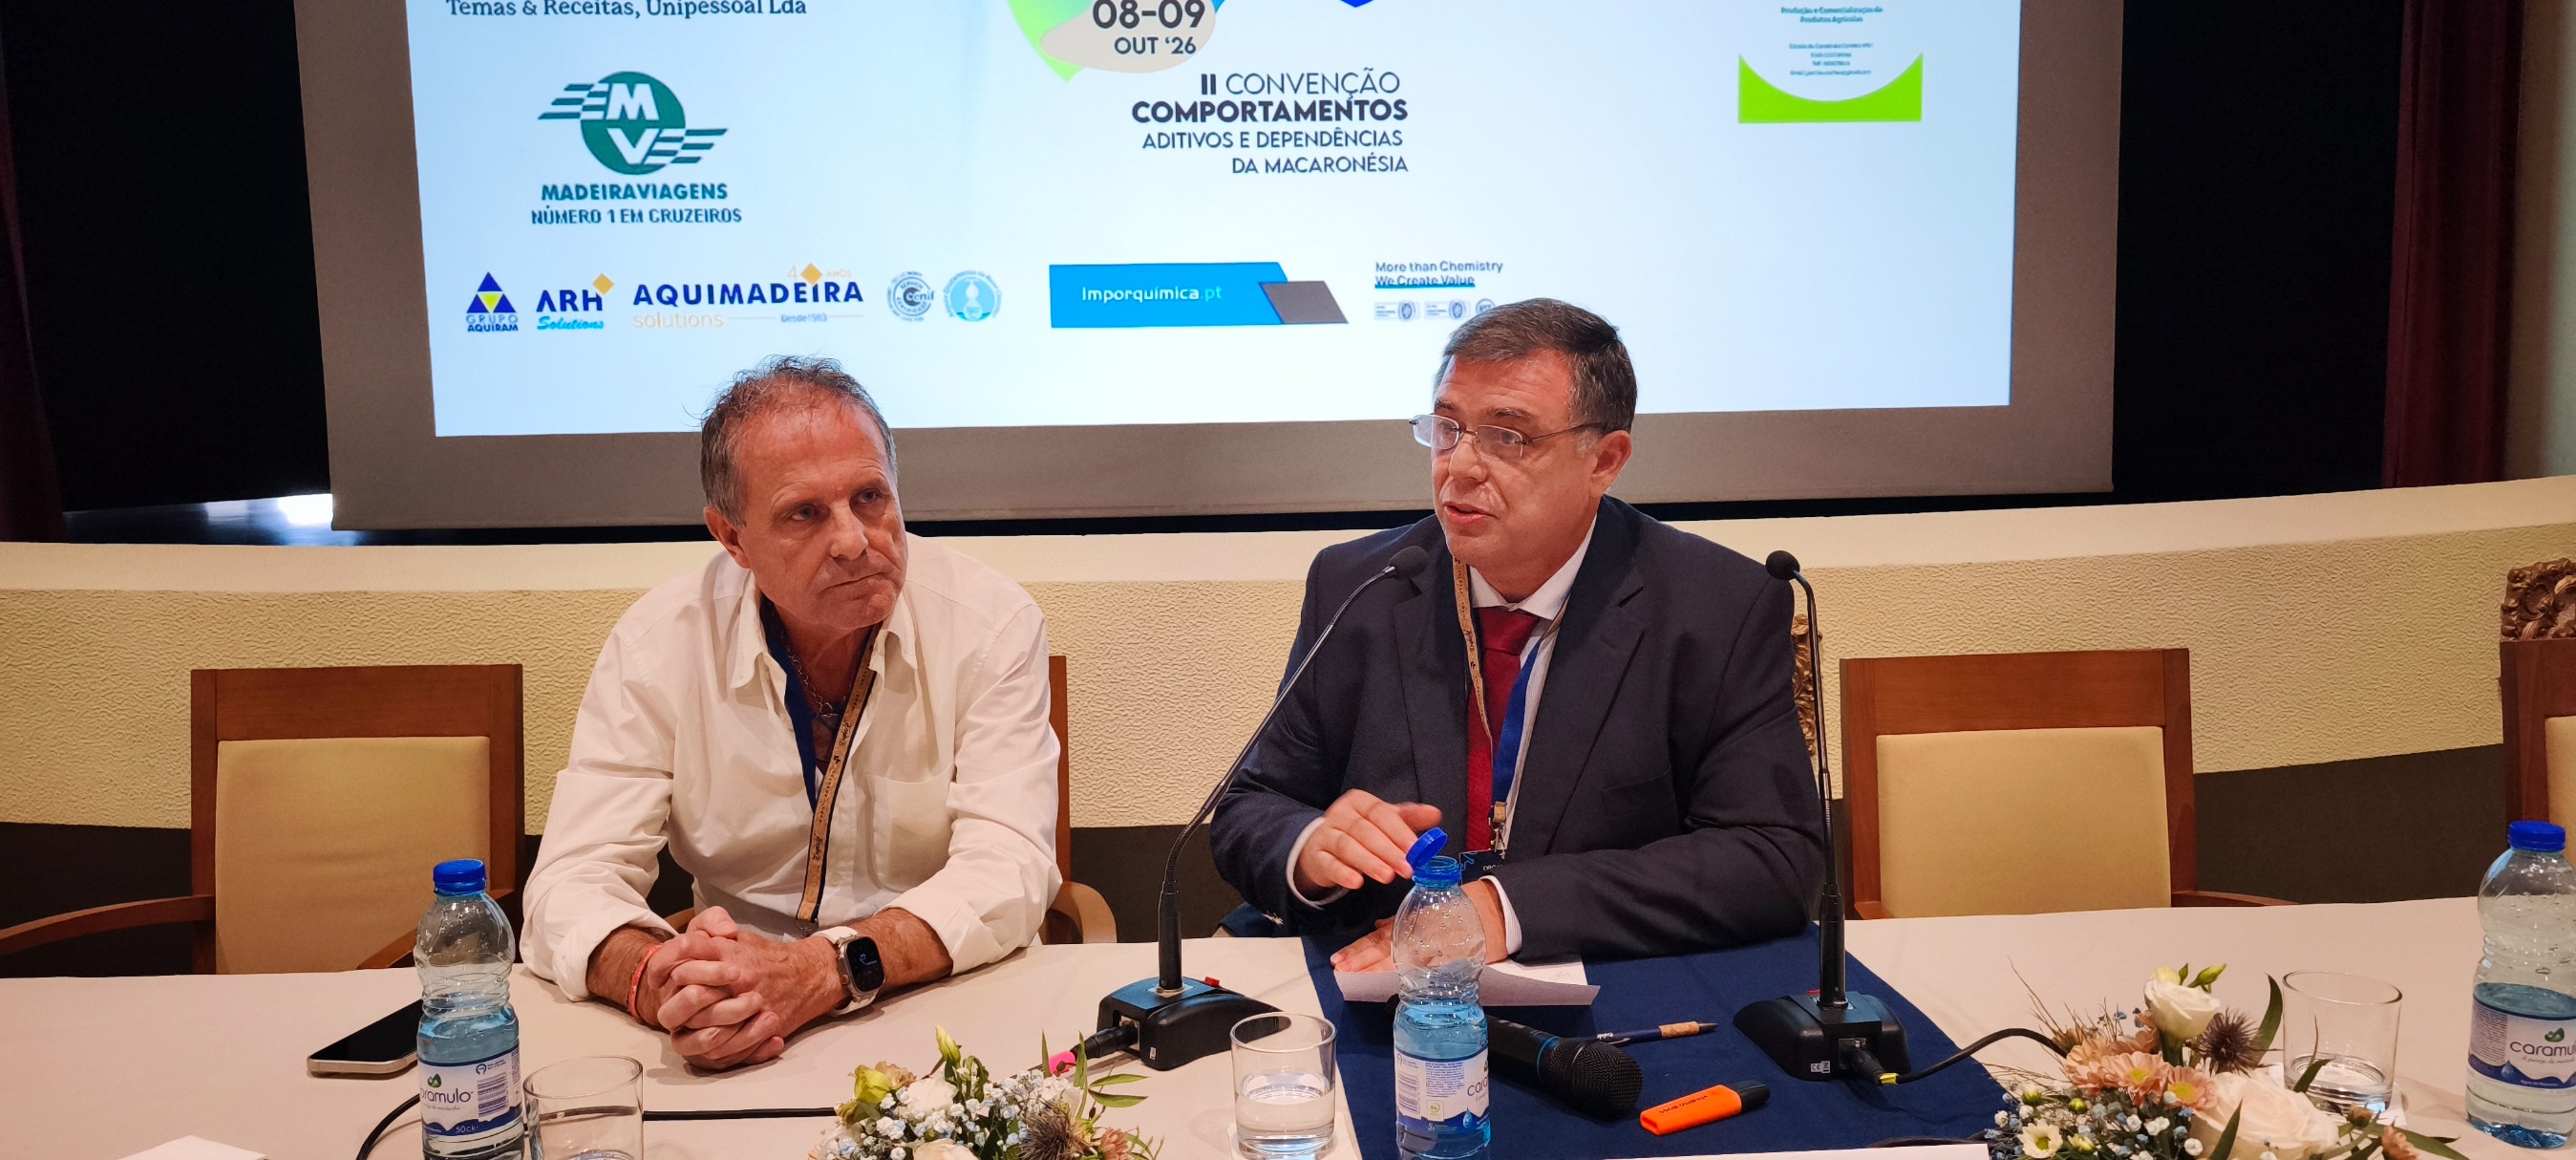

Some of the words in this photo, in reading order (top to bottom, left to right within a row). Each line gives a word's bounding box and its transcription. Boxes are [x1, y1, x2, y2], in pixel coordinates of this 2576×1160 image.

[446, 0, 517, 16] Temas
[522, 0, 538, 16] &
[543, 0, 641, 19] Receitas,
[646, 0, 763, 19] Unipessoal
[769, 0, 807, 14] Lda
[1093, 0, 1205, 30] 08-09
[1114, 36, 1159, 55] OUT
[1201, 73, 1217, 96] II
[1225, 67, 1400, 99] CONVENÇÃO
[606, 83, 659, 120] M
[1132, 98, 1409, 123] COMPORTAMENTOS
[1142, 131, 1234, 149] ADITIVOS
[1240, 131, 1250, 148] E
[1256, 126, 1403, 148] DEPENDÊNCIAS
[1232, 157, 1259, 174] DA
[1265, 152, 1409, 174] MACARONÉSIA
[541, 183, 729, 202] MADEIRAVIAGENS
[531, 204, 602, 225] NÚMERO
[607, 208, 616, 224] 1
[621, 208, 644, 224] EM
[649, 207, 742, 224] CRUZEIROS
[1374, 262, 1407, 272] More
[1409, 261, 1437, 272] than
[1439, 260, 1504, 274] Chemistry
[1374, 275, 1395, 286] We
[1396, 274, 1439, 286] Create
[1440, 274, 1476, 285] Value
[536, 289, 604, 312] ARH
[632, 282, 864, 308] AQUIMADEIRA
[466, 313, 519, 325] GRUPO
[467, 323, 519, 333] AQUIRAM
[537, 315, 605, 331] Solutions
[632, 311, 725, 329] solutions
